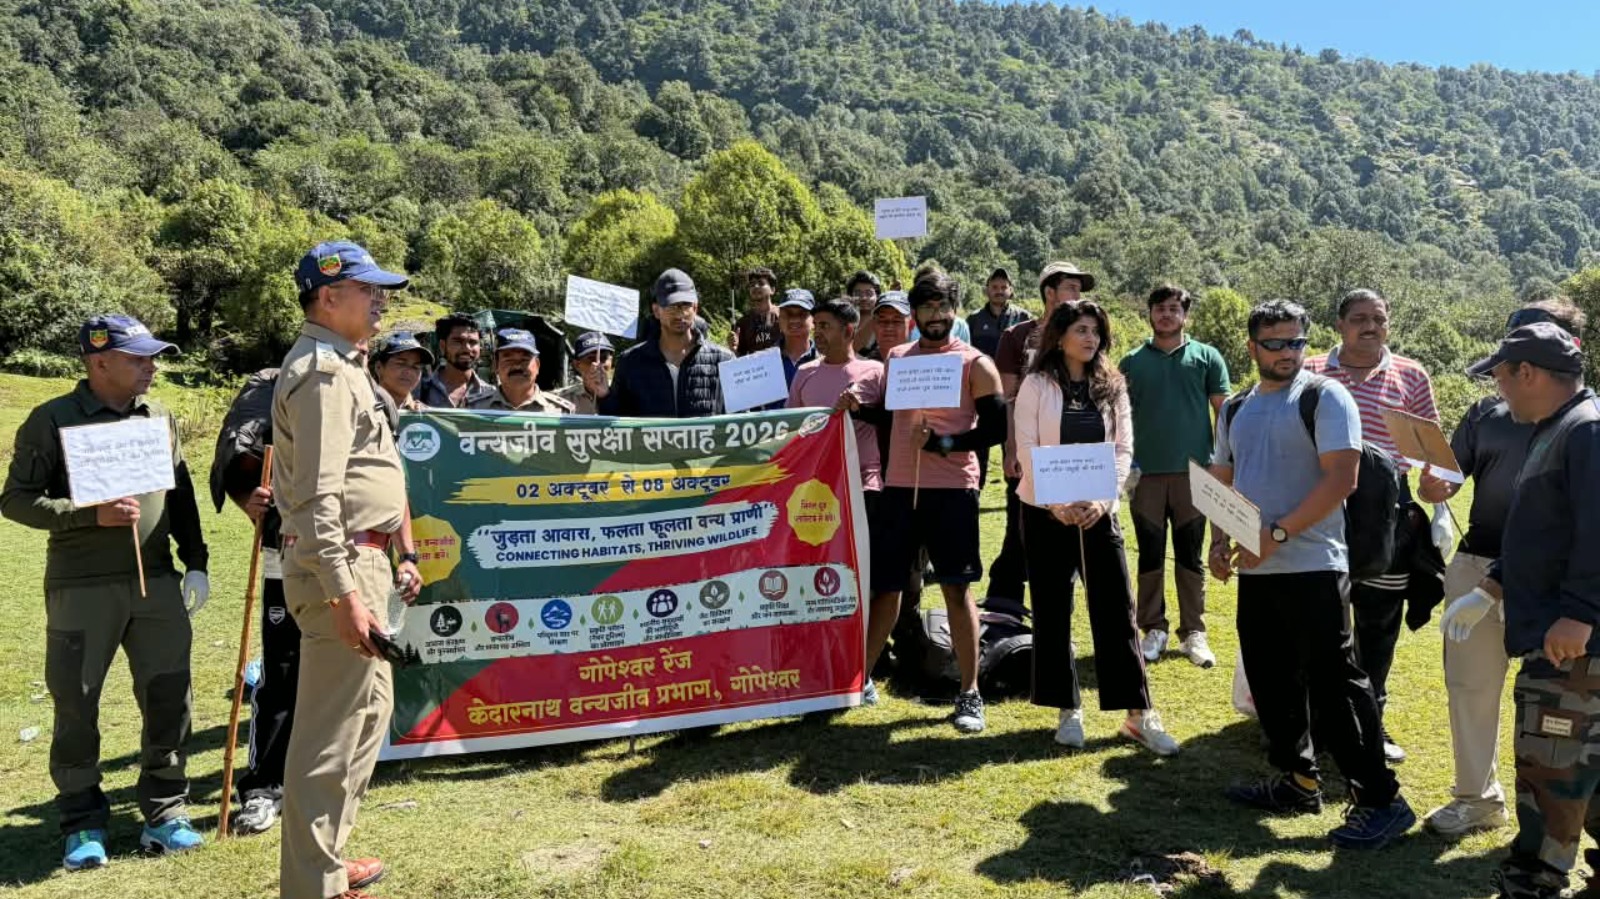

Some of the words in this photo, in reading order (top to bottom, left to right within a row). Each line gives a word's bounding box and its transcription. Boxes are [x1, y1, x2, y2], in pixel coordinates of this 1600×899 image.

[458, 420, 557, 455] वन्यजीव
[564, 426, 633, 463] सुरक्षा
[641, 424, 716, 454] सप्ताह
[725, 421, 790, 448] 2026
[517, 483, 540, 498] 02
[548, 480, 612, 501] अक्टूबर
[621, 474, 636, 495] से
[643, 477, 665, 492] 08
[671, 474, 731, 494] अक्टूबर
[496, 547, 580, 562] CONNECTING
[582, 542, 646, 556] HABITATS,
[648, 536, 705, 552] THRIVING
[705, 525, 758, 544] WILDLIFE
[541, 527, 596, 544] आवास,
[600, 521, 645, 540] फलता
[648, 516, 692, 539] फूलता
[696, 513, 726, 529] वन्य
[579, 655, 656, 684] गोपेश्वर
[659, 646, 693, 674] रेंज
[467, 697, 562, 725] केदारनाथ
[569, 682, 650, 715] वन्यजीव
[656, 678, 723, 705] प्रभाग,
[730, 665, 801, 694] गोपेश्वर
